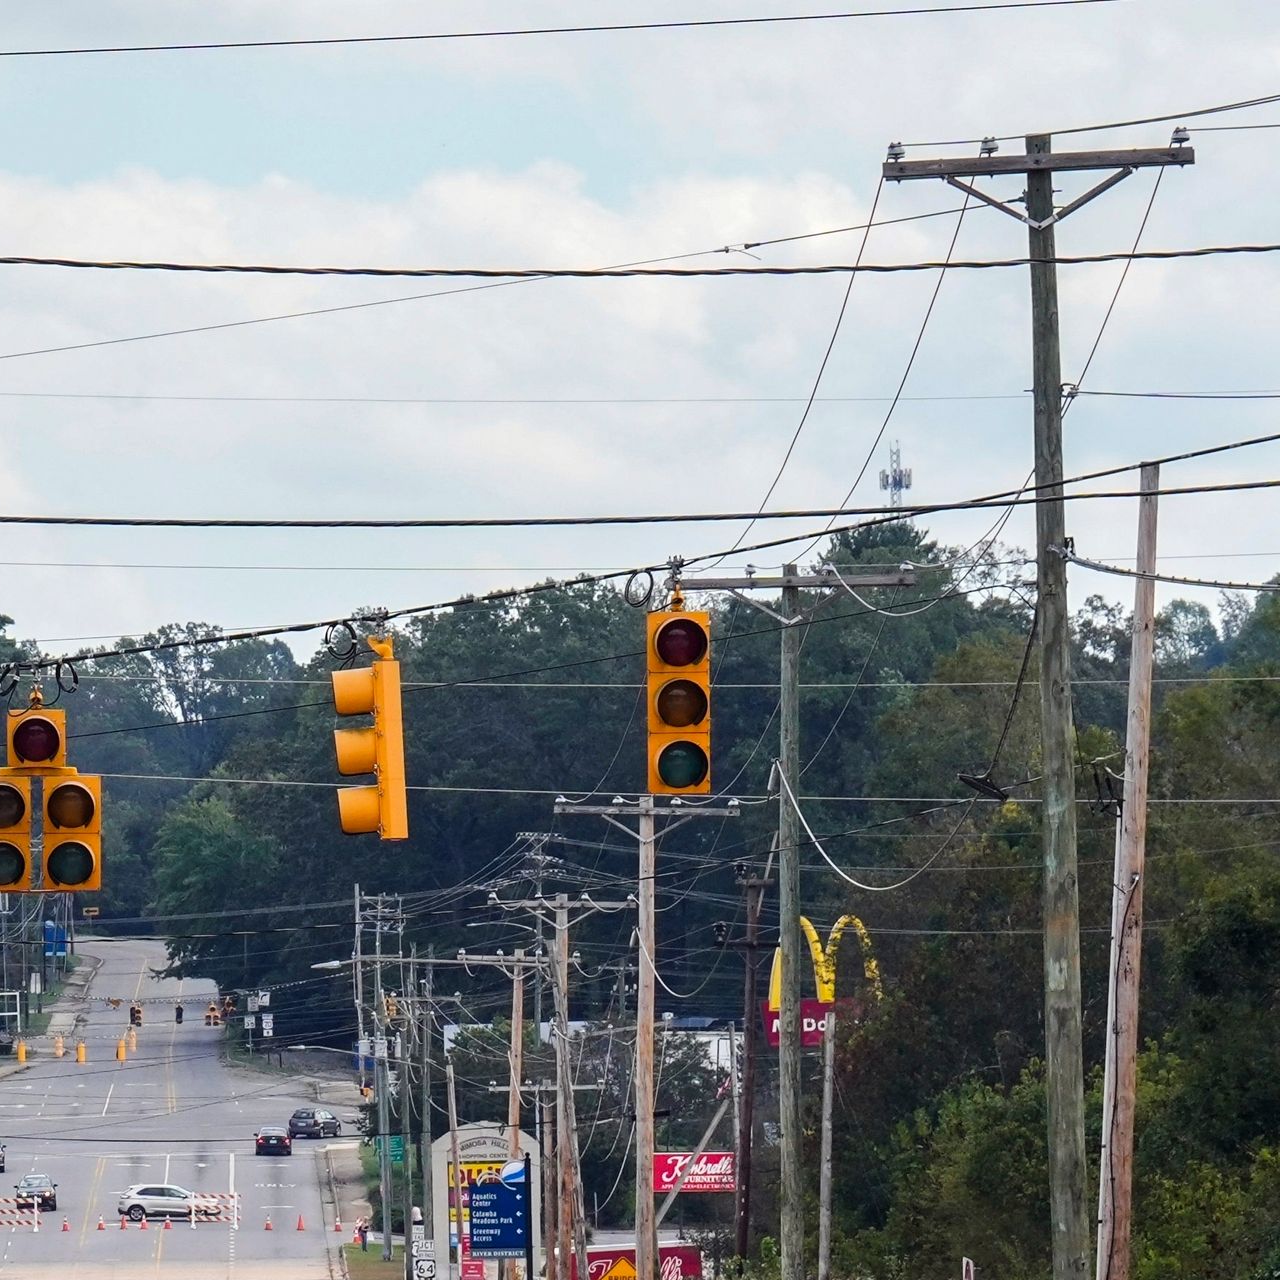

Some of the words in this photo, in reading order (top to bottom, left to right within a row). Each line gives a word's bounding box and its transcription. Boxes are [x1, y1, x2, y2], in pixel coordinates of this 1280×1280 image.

[661, 1155, 734, 1182] Kmbrell's
[472, 1193, 497, 1203] Aquatics
[473, 1228, 501, 1236] Greenway
[418, 1264, 433, 1274] 64
